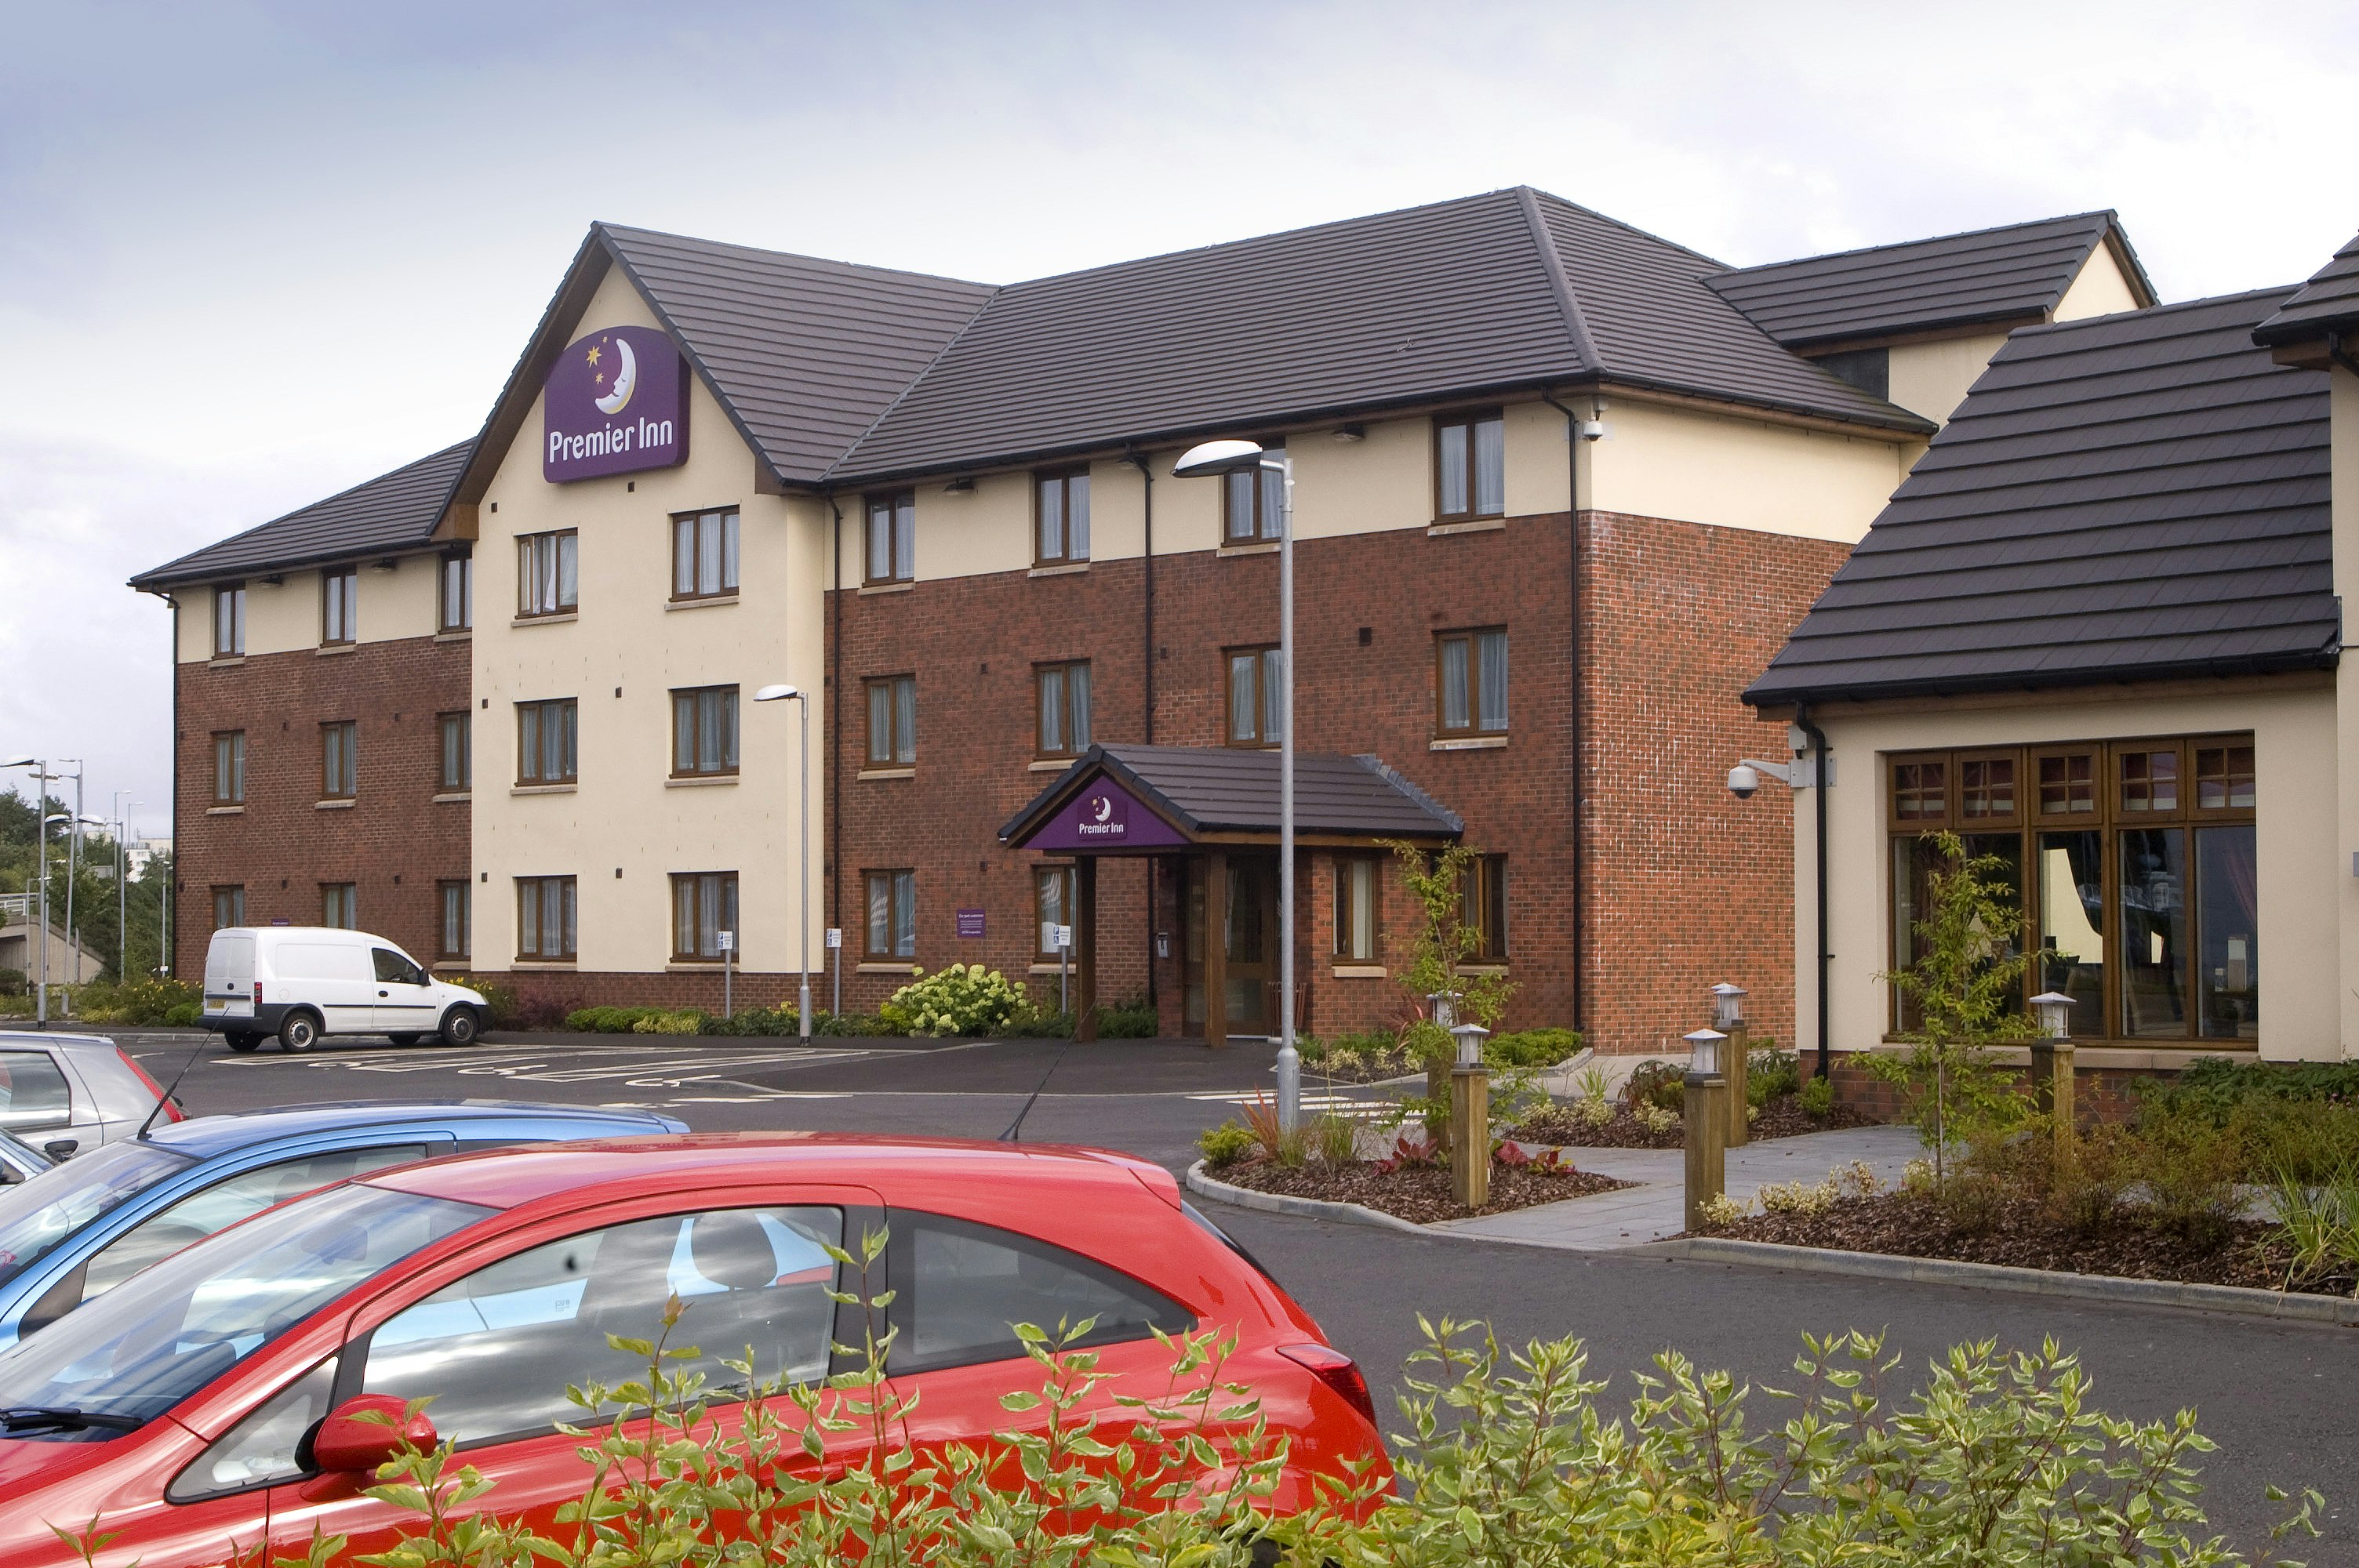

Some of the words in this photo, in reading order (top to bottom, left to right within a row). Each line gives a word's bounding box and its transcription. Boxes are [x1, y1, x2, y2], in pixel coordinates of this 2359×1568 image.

[549, 423, 634, 463] Premier
[639, 416, 673, 449] Inn
[1078, 822, 1110, 835] Premier
[1110, 822, 1124, 833] Inn
